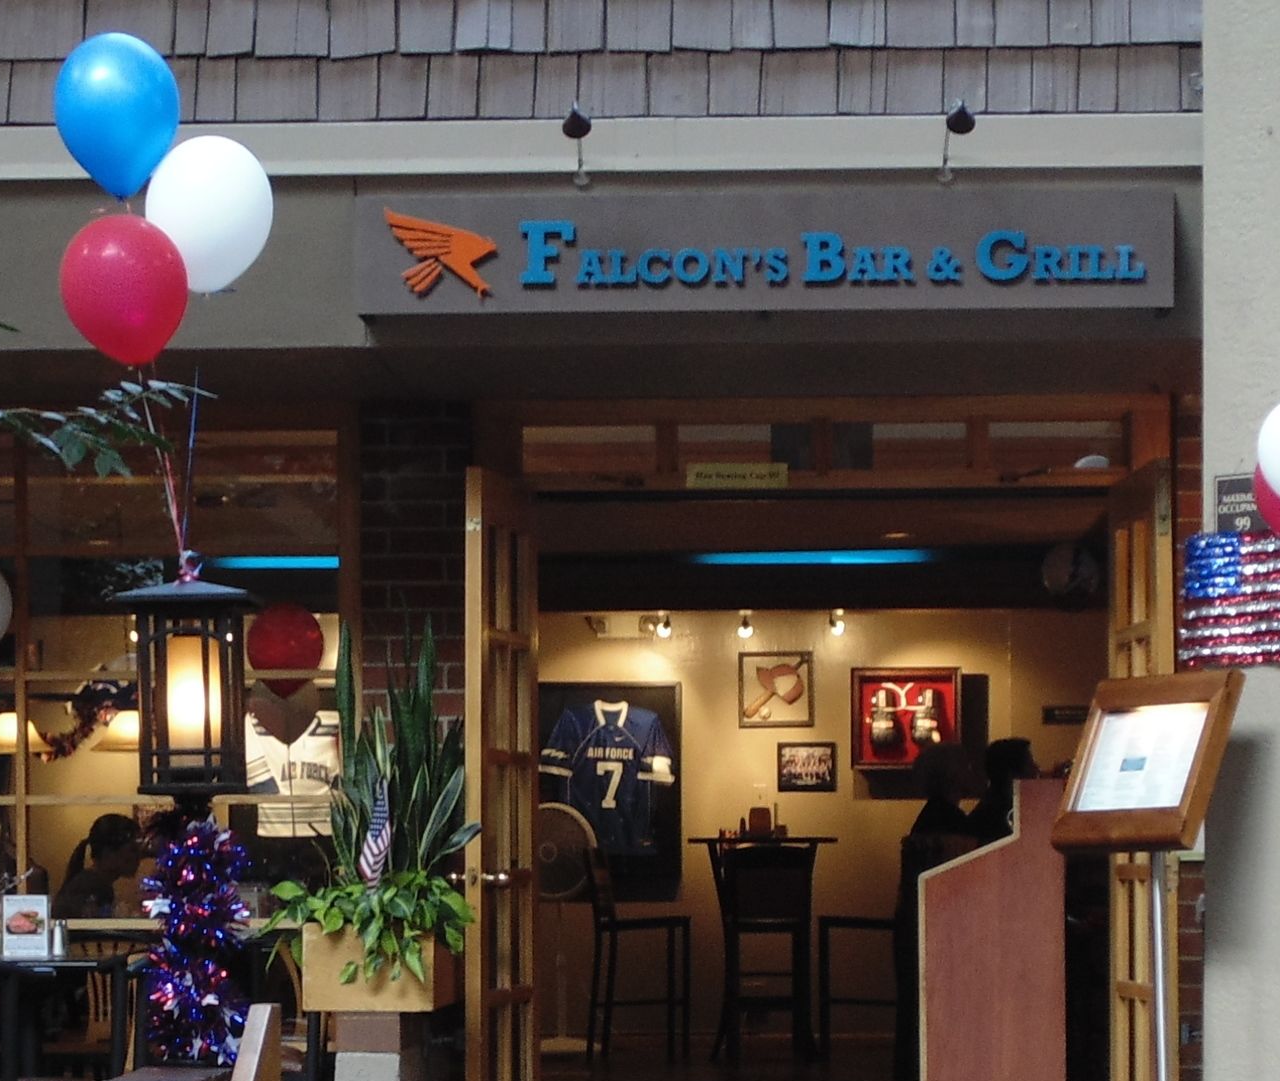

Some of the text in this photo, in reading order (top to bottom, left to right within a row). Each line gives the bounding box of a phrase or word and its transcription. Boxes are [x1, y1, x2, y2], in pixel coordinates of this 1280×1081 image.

[520, 219, 1145, 288] FALCON'S BAR & GRILL
[1219, 503, 1258, 514] OCCUPAN
[1235, 516, 1251, 531] 99
[587, 747, 634, 760] AIR FORCE
[596, 761, 624, 809] 7
